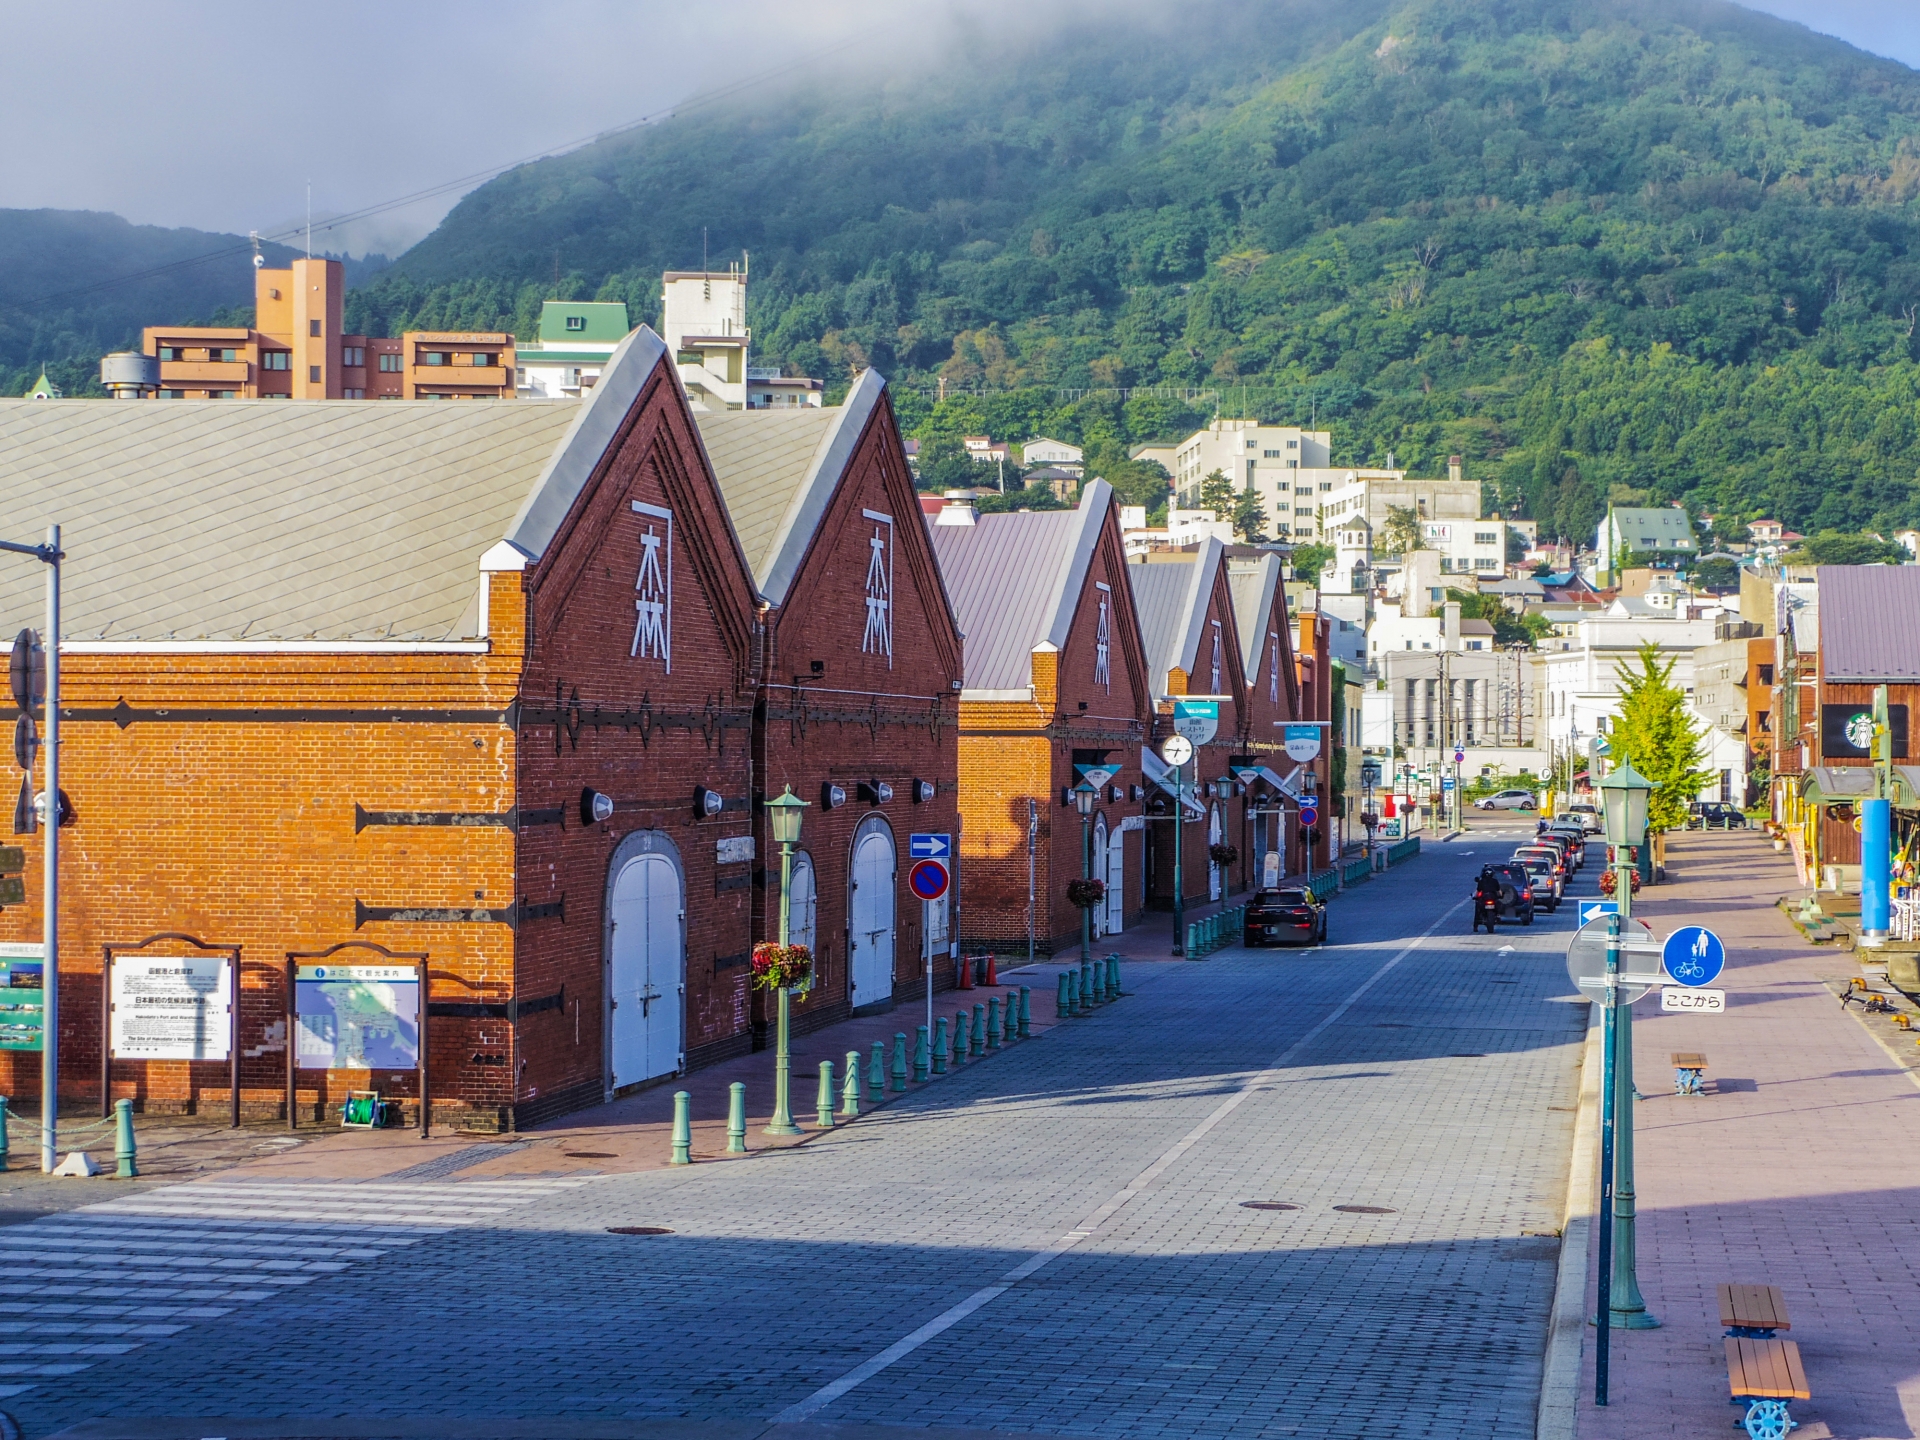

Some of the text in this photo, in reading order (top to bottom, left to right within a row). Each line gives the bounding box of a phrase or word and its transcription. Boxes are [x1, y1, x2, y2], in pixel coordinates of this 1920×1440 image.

[330, 969, 399, 977] はこだて観光案内
[1666, 994, 1721, 1009] ここから
